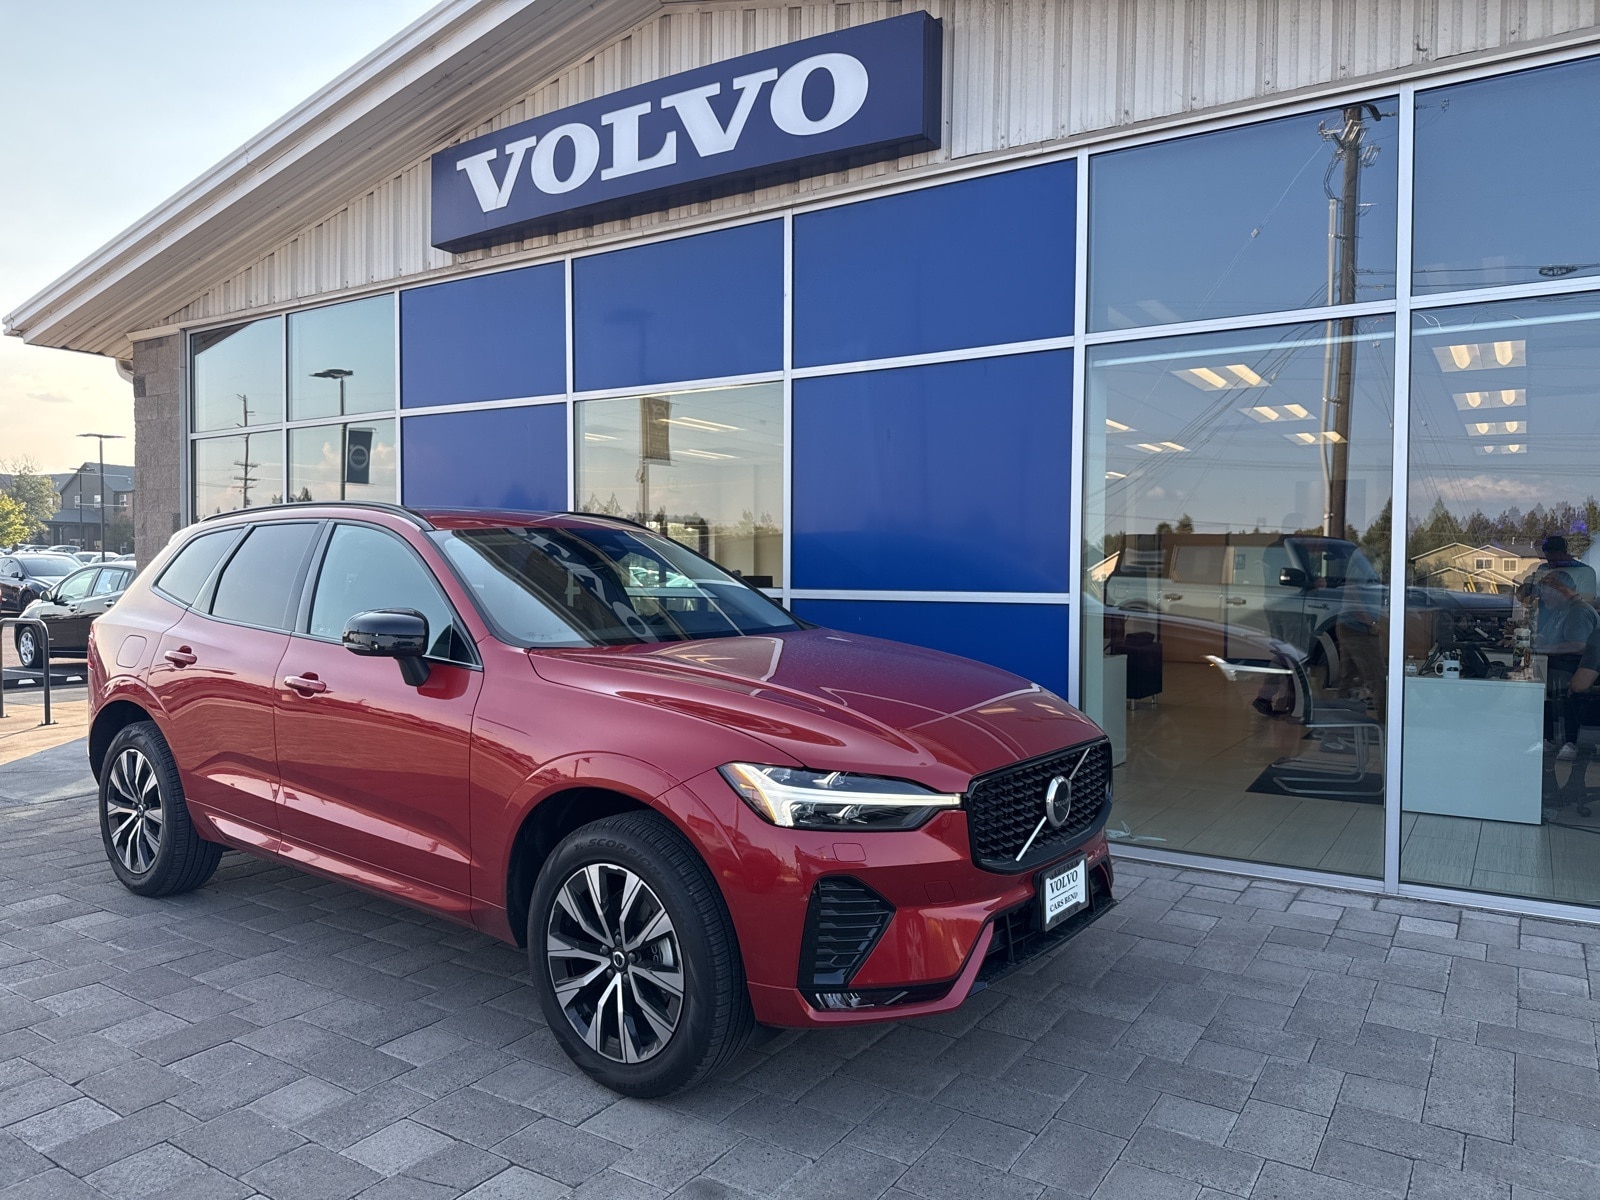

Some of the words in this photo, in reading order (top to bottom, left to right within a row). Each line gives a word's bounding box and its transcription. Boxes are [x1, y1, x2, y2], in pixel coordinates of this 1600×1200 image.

[456, 52, 869, 213] VOLVO
[1049, 870, 1078, 894] VOLVO
[1049, 900, 1064, 912] CARS
